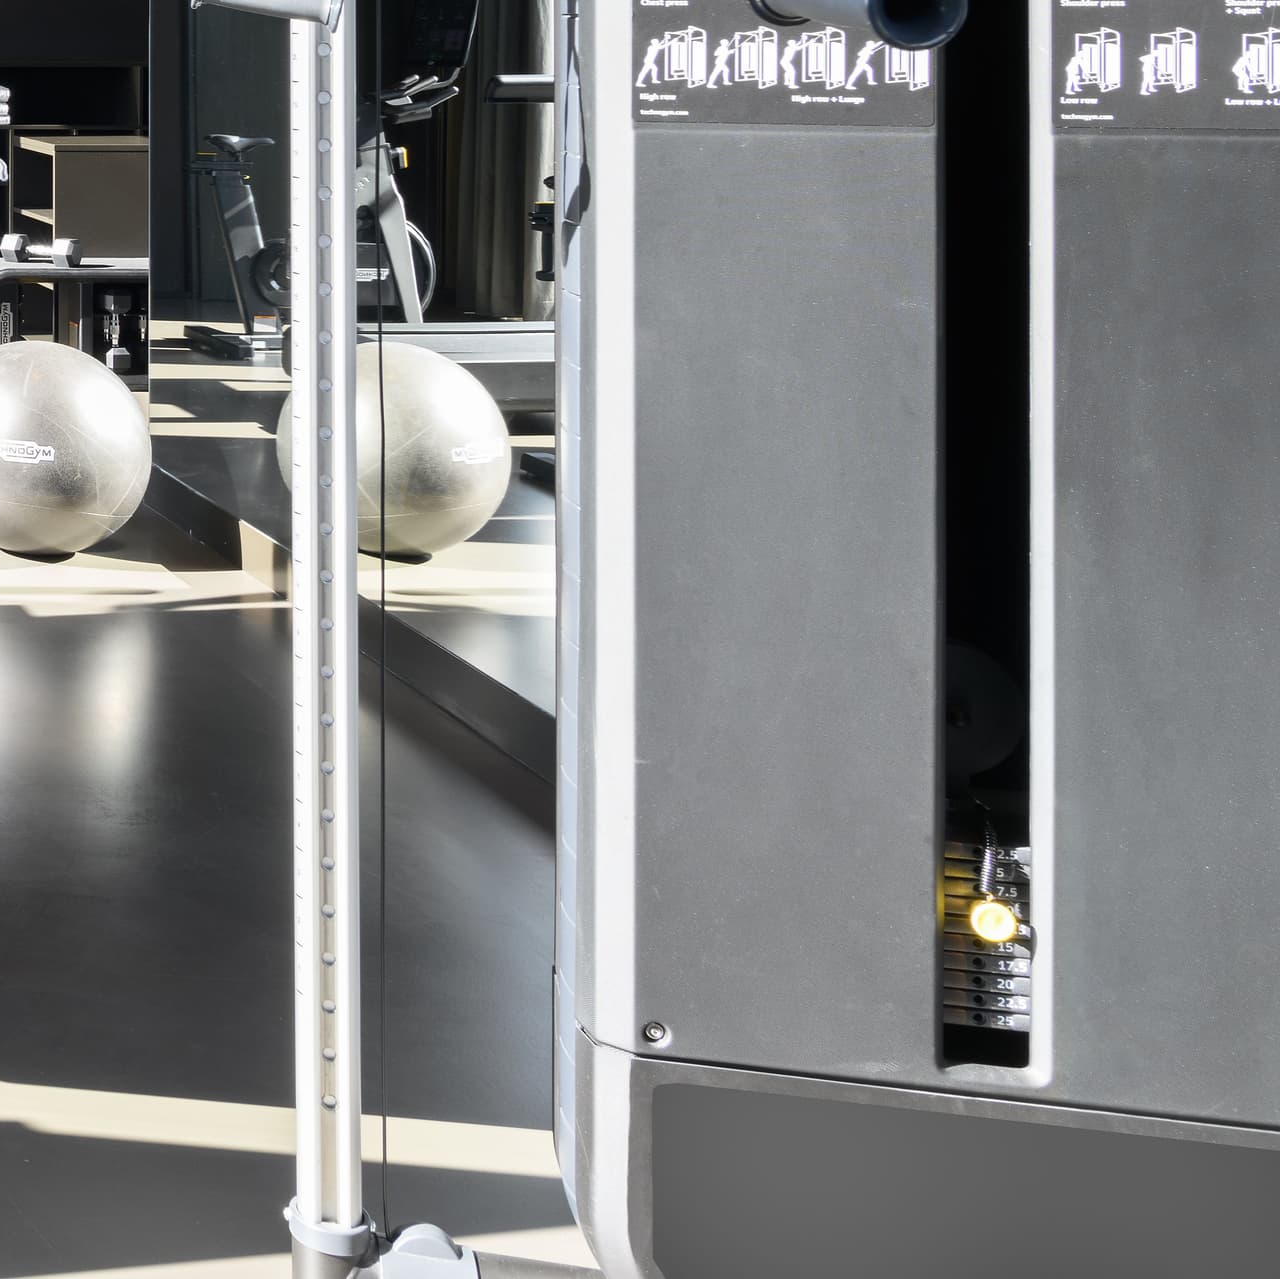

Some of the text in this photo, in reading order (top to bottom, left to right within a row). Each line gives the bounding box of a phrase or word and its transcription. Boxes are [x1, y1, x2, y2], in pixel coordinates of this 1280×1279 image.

[1060, 0, 1126, 8] Shoulder press
[996, 849, 1017, 860] 2.5
[996, 867, 1005, 878] 5
[996, 886, 1017, 897] 7.5
[998, 942, 1014, 953] 15
[998, 960, 1028, 973] 17.5
[997, 978, 1014, 990] 20
[997, 997, 1027, 1010] 22.5
[997, 1015, 1014, 1026] 25
